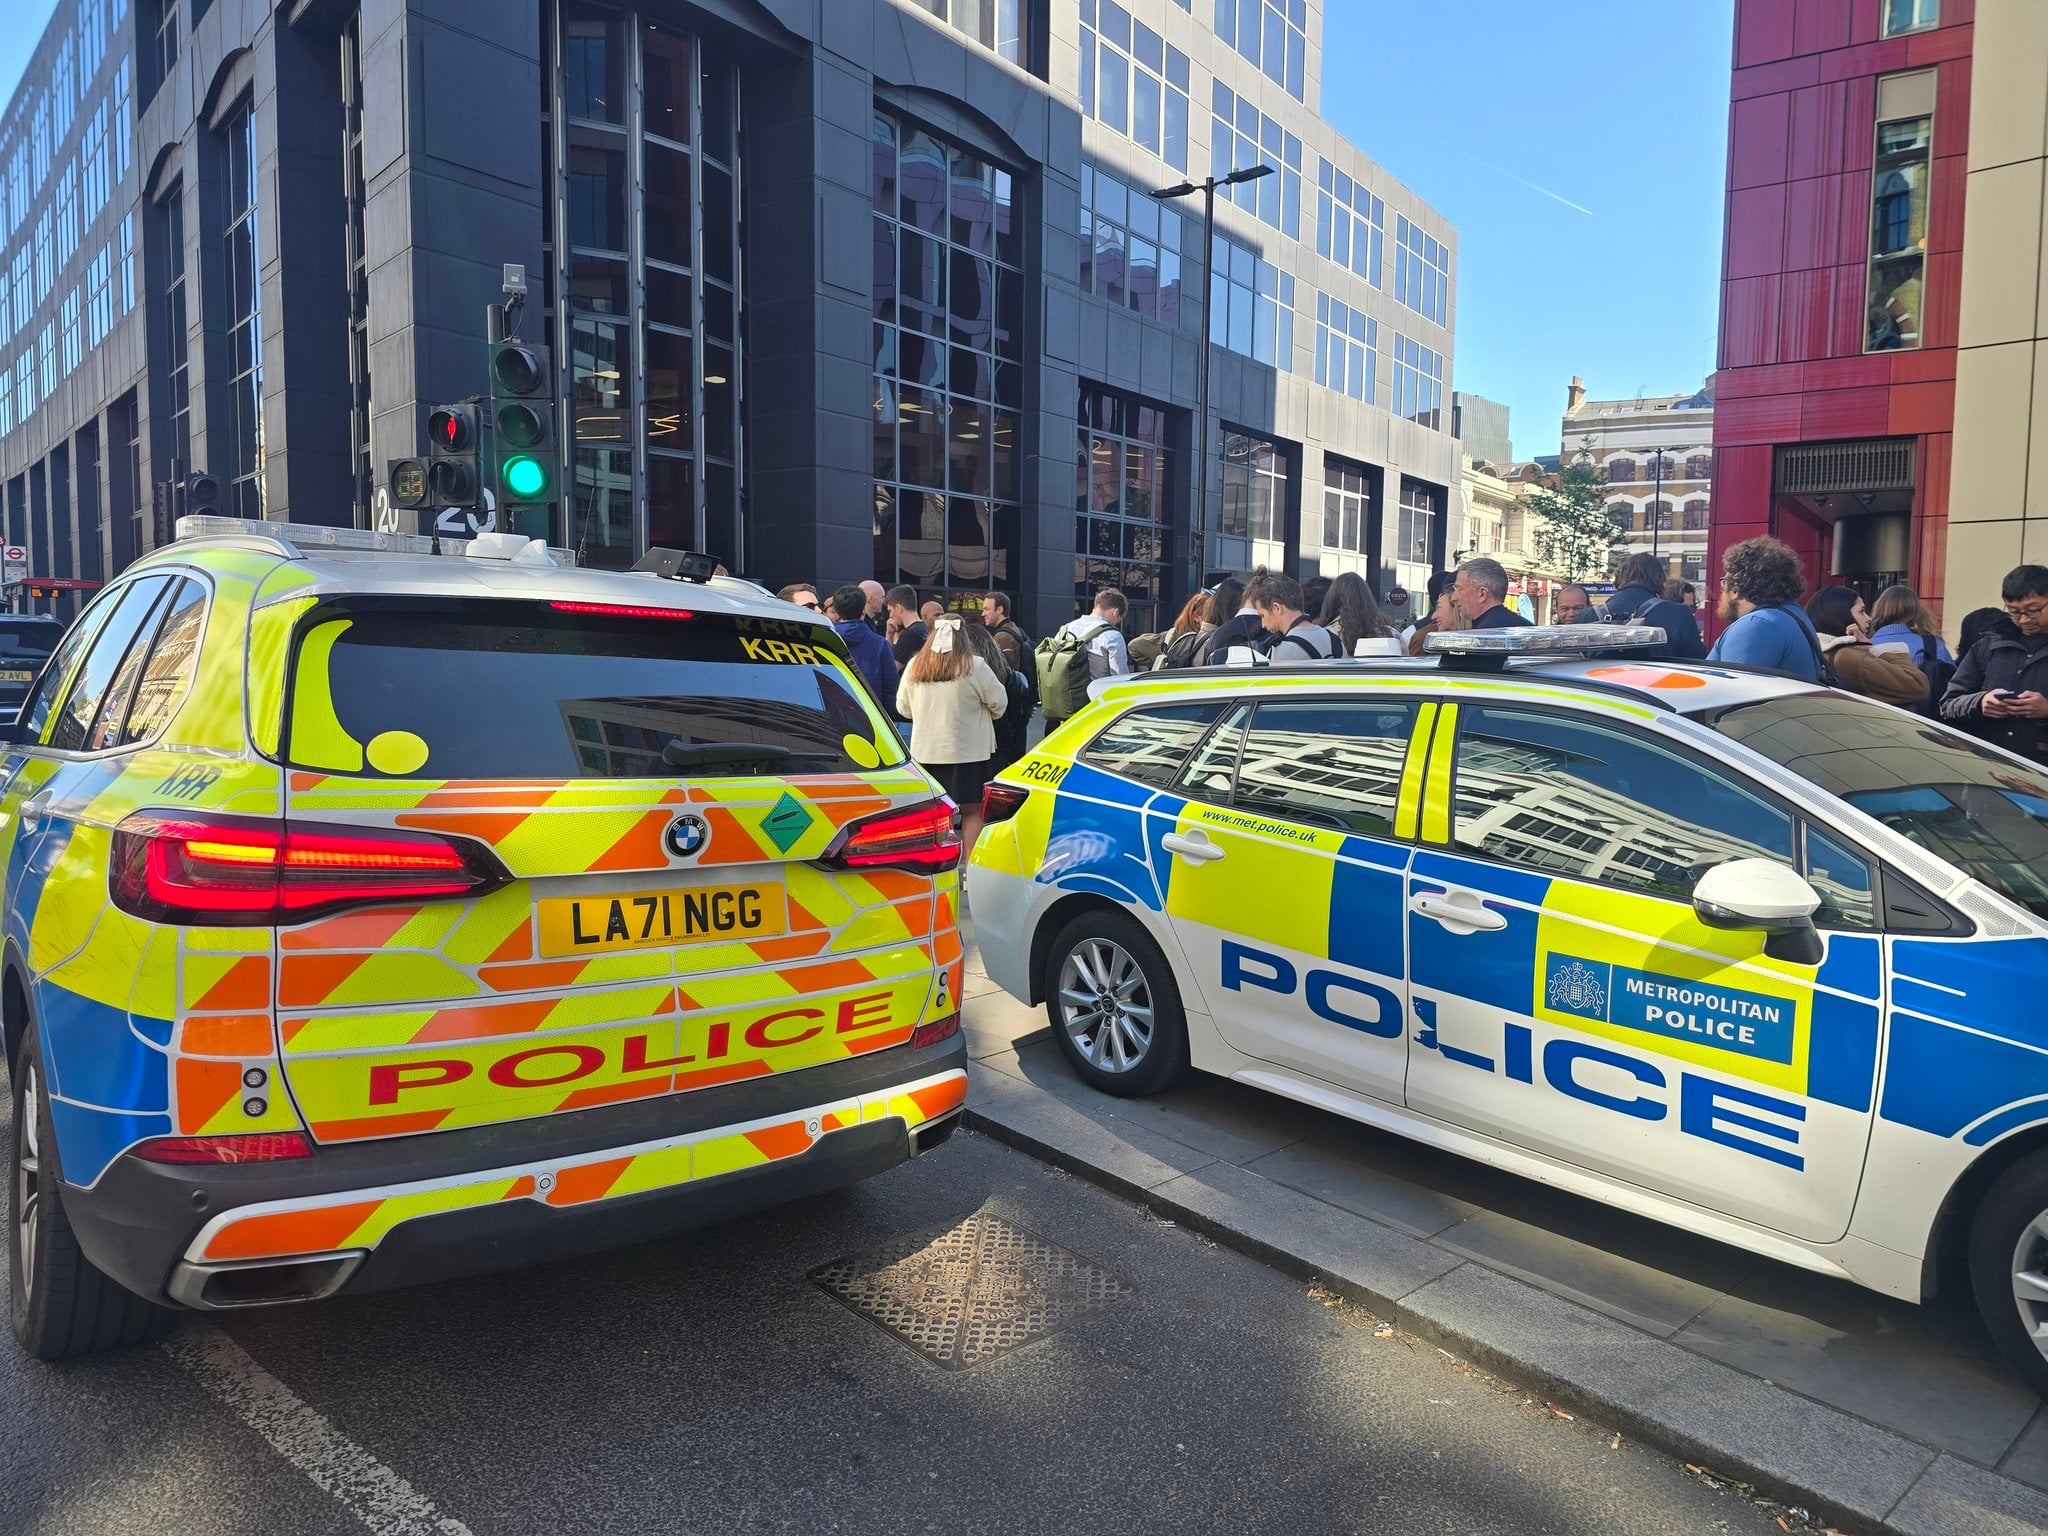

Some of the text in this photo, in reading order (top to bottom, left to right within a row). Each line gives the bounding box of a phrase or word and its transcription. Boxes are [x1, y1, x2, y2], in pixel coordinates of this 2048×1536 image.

[738, 636, 822, 667] KRR
[8, 671, 28, 680] AVL
[152, 762, 223, 800] KRR
[1021, 761, 1069, 785] RGM
[672, 818, 705, 832] BMW
[1202, 809, 1318, 843] www.met.police.uk
[572, 889, 762, 945] LA71 NGG
[1626, 978, 1780, 1024] METROPOLITAN
[1646, 1005, 1756, 1045] POLICE
[369, 991, 894, 1106] POLICE
[1221, 939, 1807, 1172] POLICE
